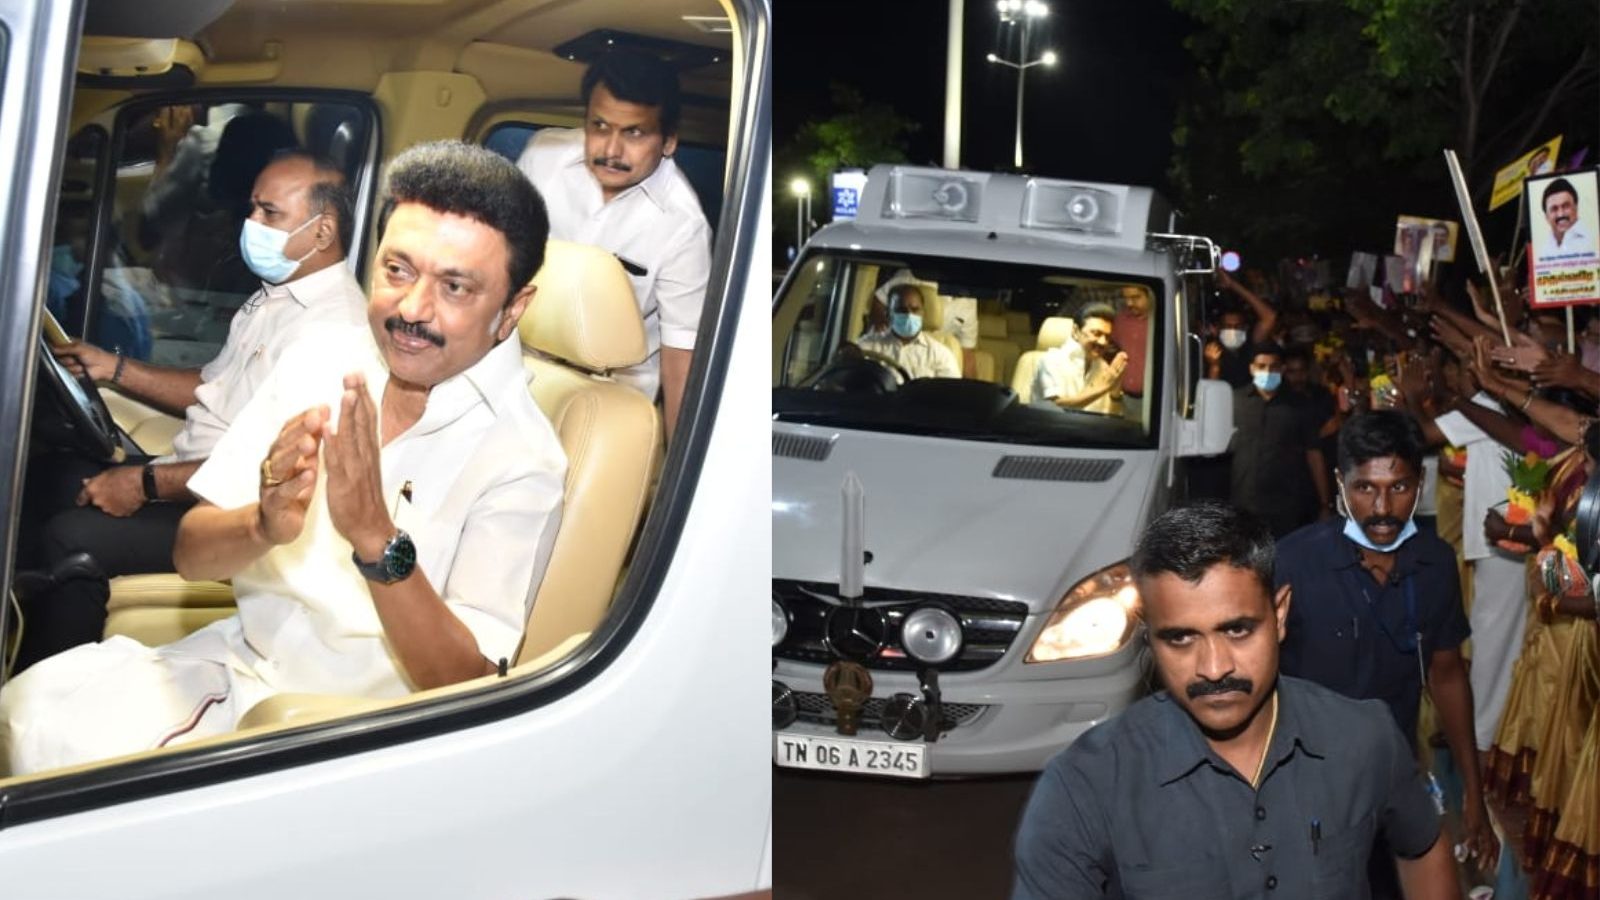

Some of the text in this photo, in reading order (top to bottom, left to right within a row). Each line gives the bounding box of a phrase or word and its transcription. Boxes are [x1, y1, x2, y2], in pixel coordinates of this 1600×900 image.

[784, 742, 918, 771] TN 06 A 2345
